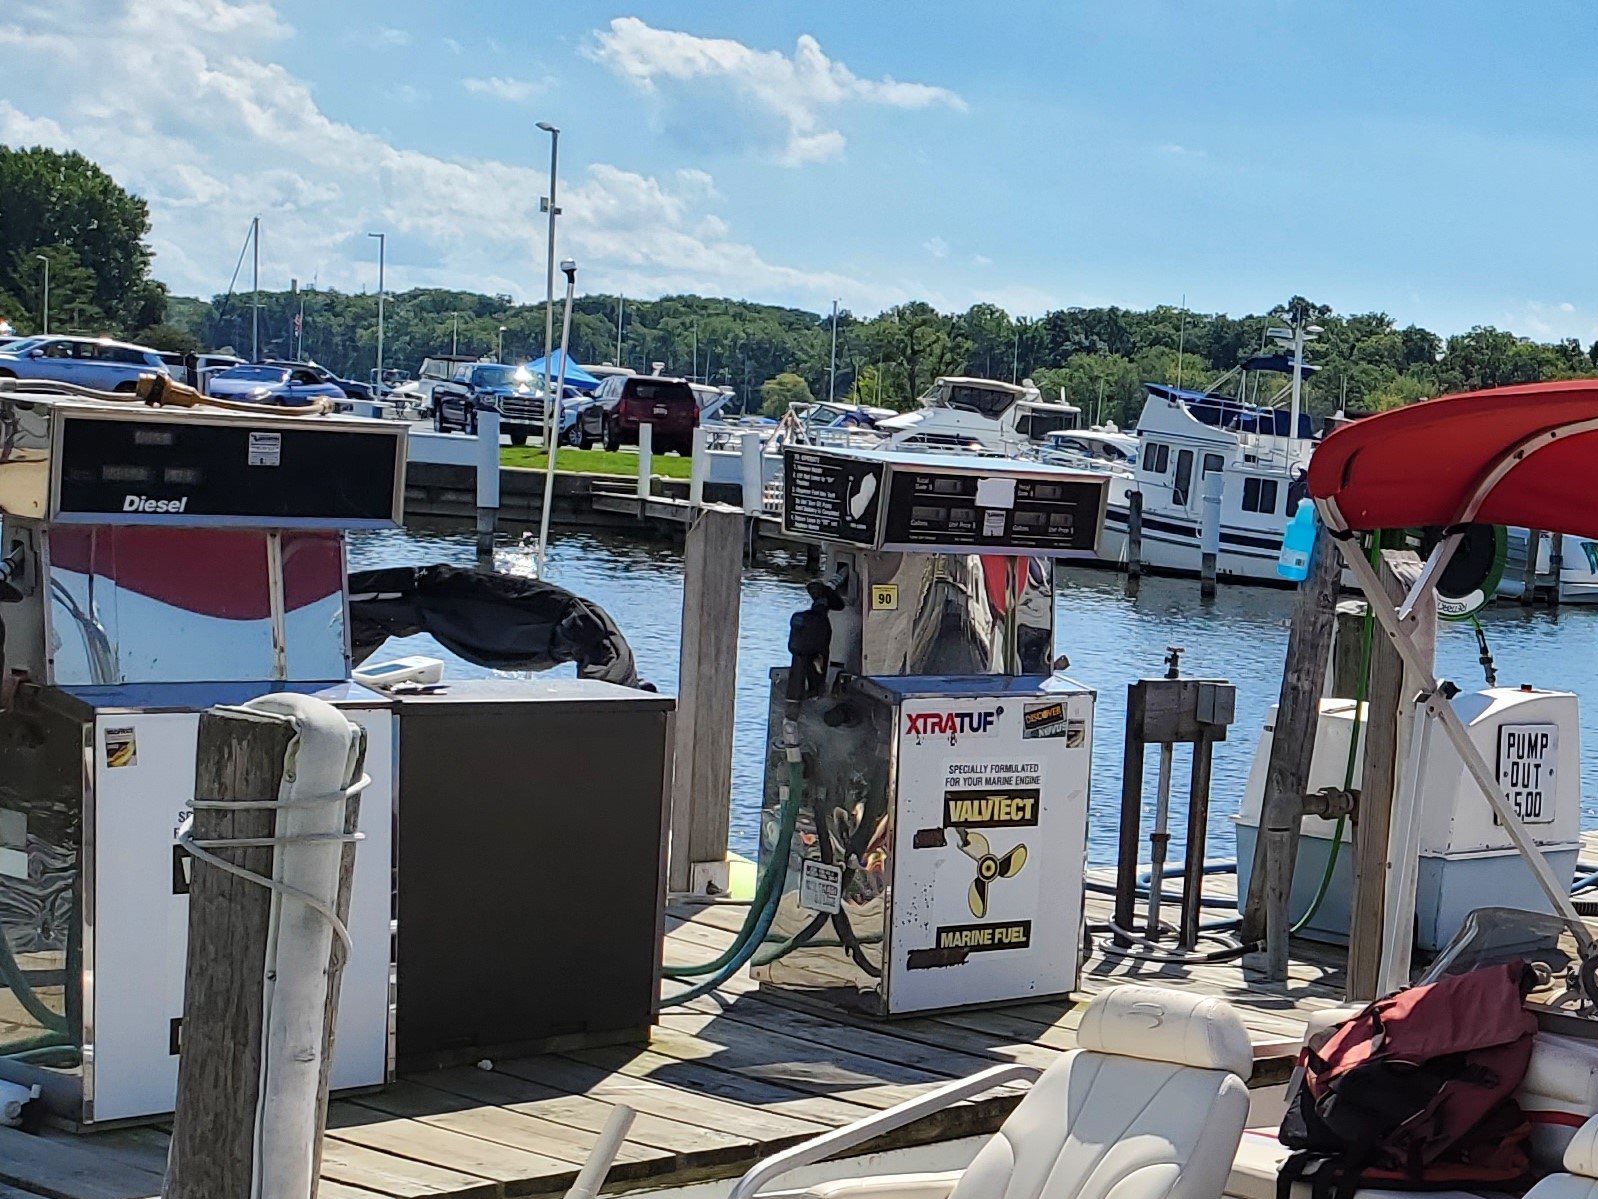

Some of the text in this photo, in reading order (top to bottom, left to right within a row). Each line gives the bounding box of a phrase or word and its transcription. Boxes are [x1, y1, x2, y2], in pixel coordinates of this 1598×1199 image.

[123, 495, 188, 513] Diesel
[878, 593, 892, 605] 90
[905, 712, 995, 735] XTRATUF
[1025, 706, 1062, 725] DISCOVER
[1038, 722, 1067, 738] NOVUS
[1507, 732, 1549, 760] PUMP
[948, 763, 1039, 775] SPECIALLY FORMULATED
[1510, 761, 1542, 790] OUT
[945, 775, 1041, 787] FOR YOUR MARINE ENGINE
[949, 795, 1035, 822] VALVTECT
[940, 926, 1027, 949] MARINE FUEL
